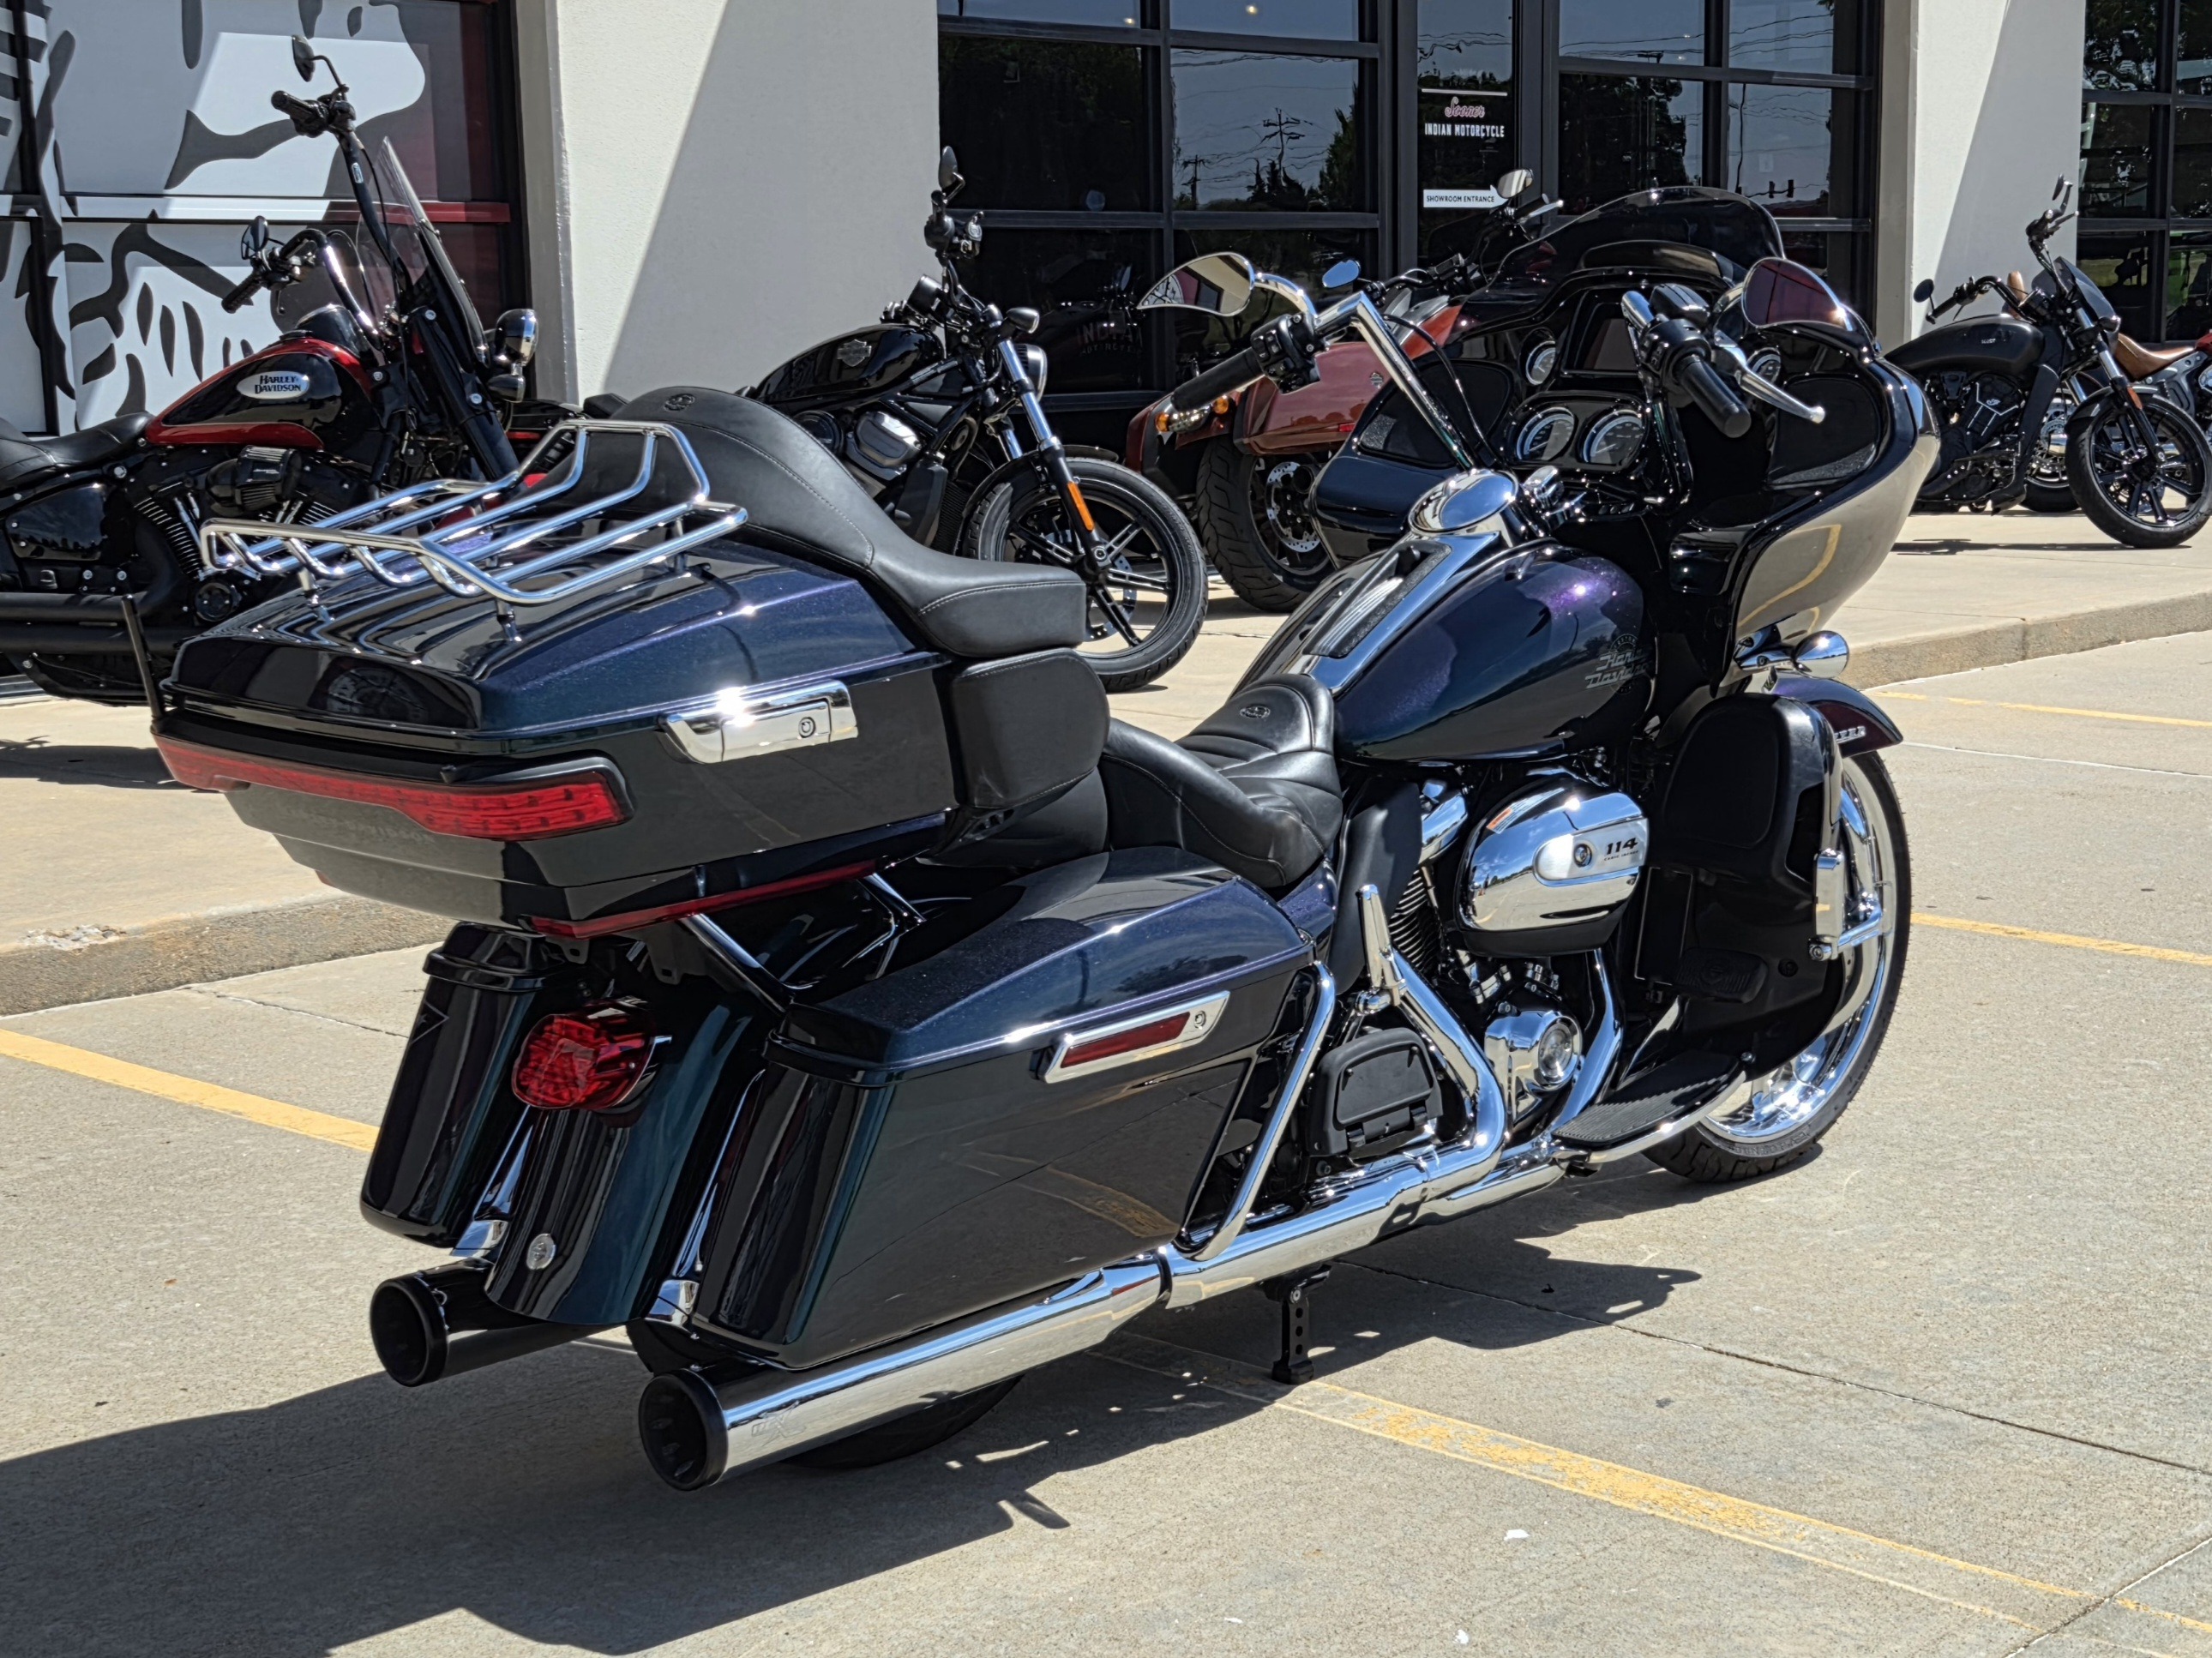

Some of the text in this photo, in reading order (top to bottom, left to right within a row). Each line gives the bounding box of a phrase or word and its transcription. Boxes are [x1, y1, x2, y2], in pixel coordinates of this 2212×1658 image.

[1445, 96, 1485, 117] Sooner
[1425, 123, 1505, 137] INDIAN MOTORCYCLE
[255, 383, 301, 394] DAVIDSON
[1607, 837, 1638, 856] 114
